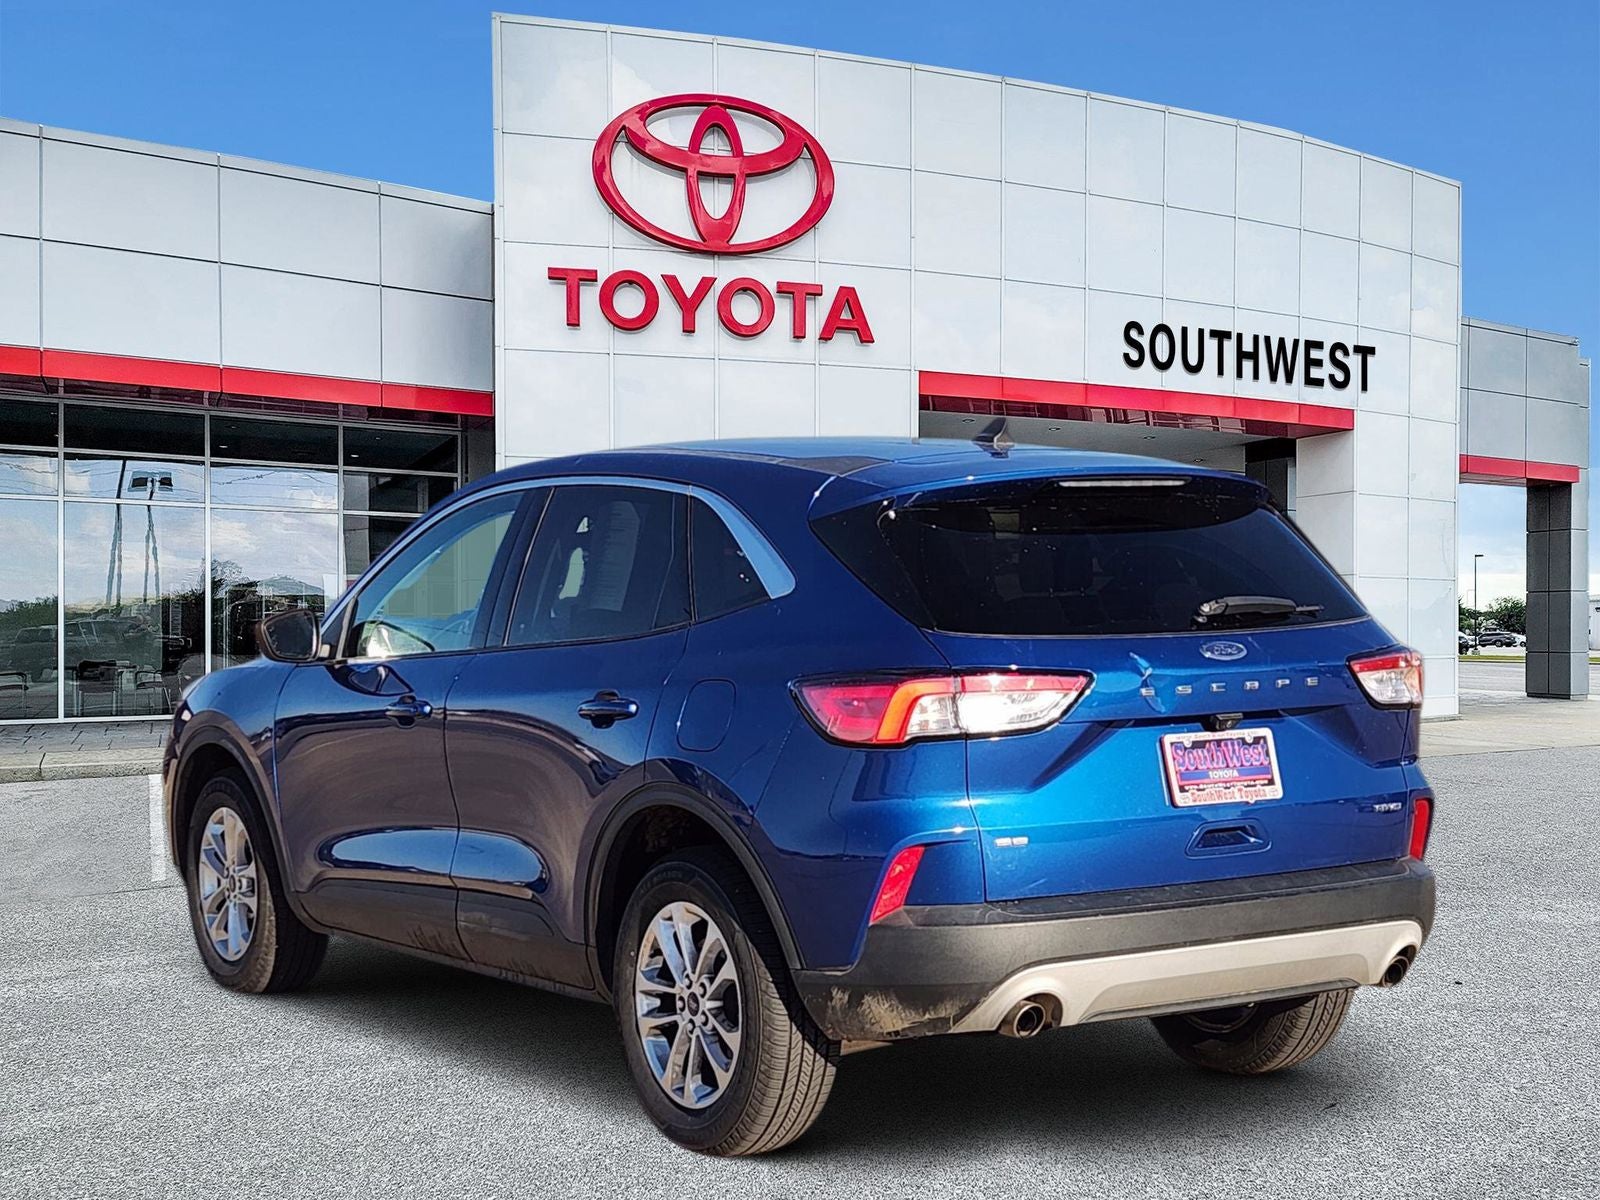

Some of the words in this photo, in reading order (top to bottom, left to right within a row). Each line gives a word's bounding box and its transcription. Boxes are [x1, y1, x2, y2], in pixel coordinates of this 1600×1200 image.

[548, 267, 875, 343] TOYOTA
[1123, 320, 1376, 392] SOUTHWEST
[1139, 676, 1319, 696] ESCAPE
[1208, 768, 1239, 779] TOYOTA
[1238, 786, 1268, 801] Toyota
